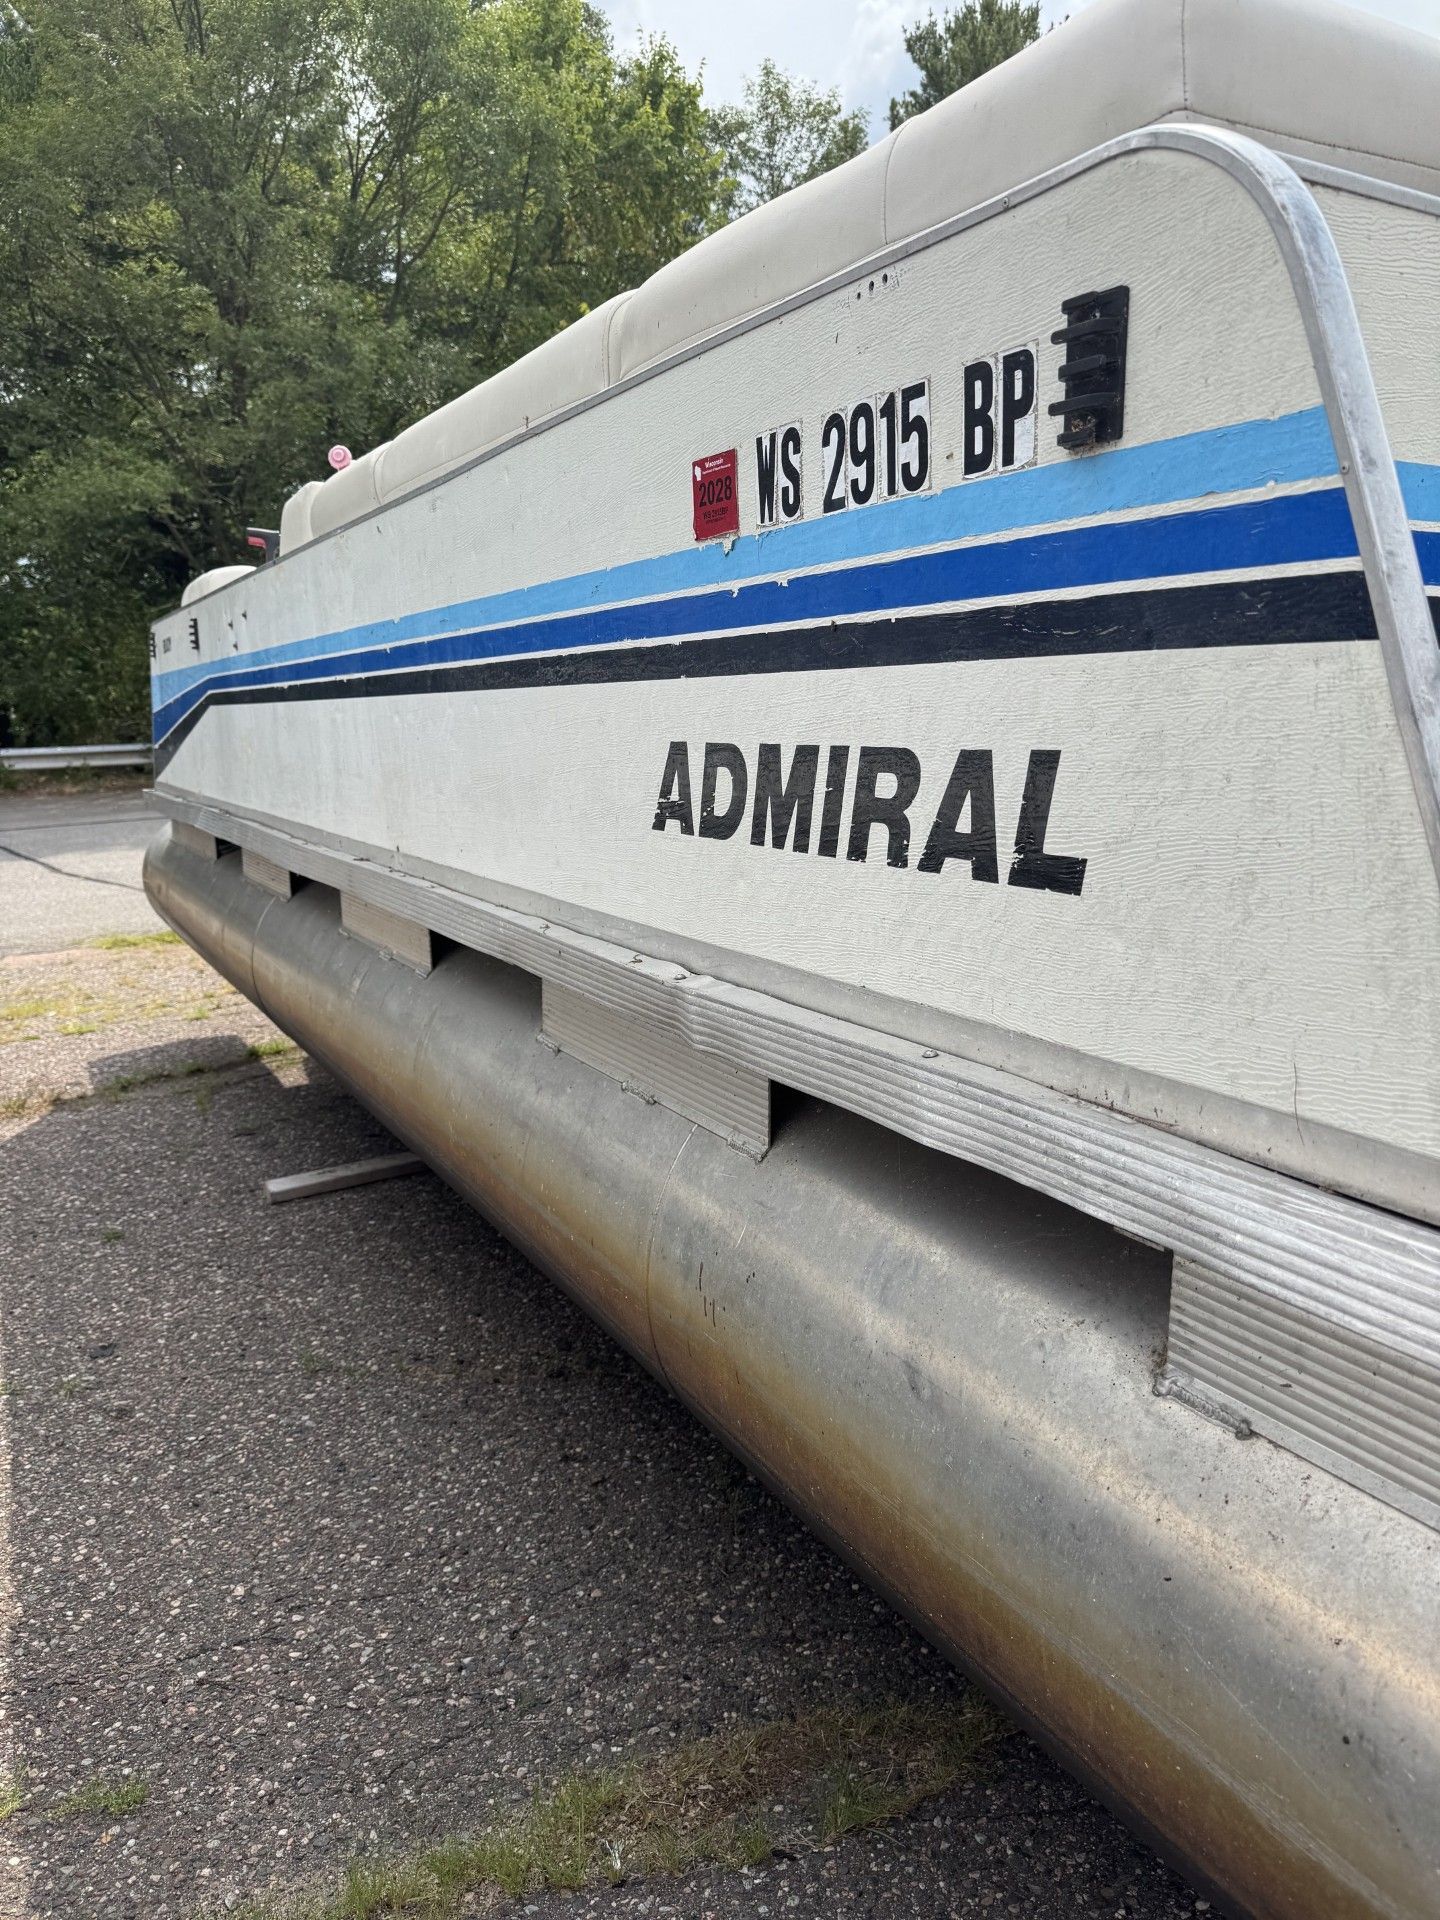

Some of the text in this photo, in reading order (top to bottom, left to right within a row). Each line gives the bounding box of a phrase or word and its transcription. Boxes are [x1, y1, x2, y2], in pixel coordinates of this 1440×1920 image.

[699, 475, 732, 507] 2028
[755, 348, 1035, 525] WS 2915 BP
[651, 740, 1088, 897] ADMIRAL
